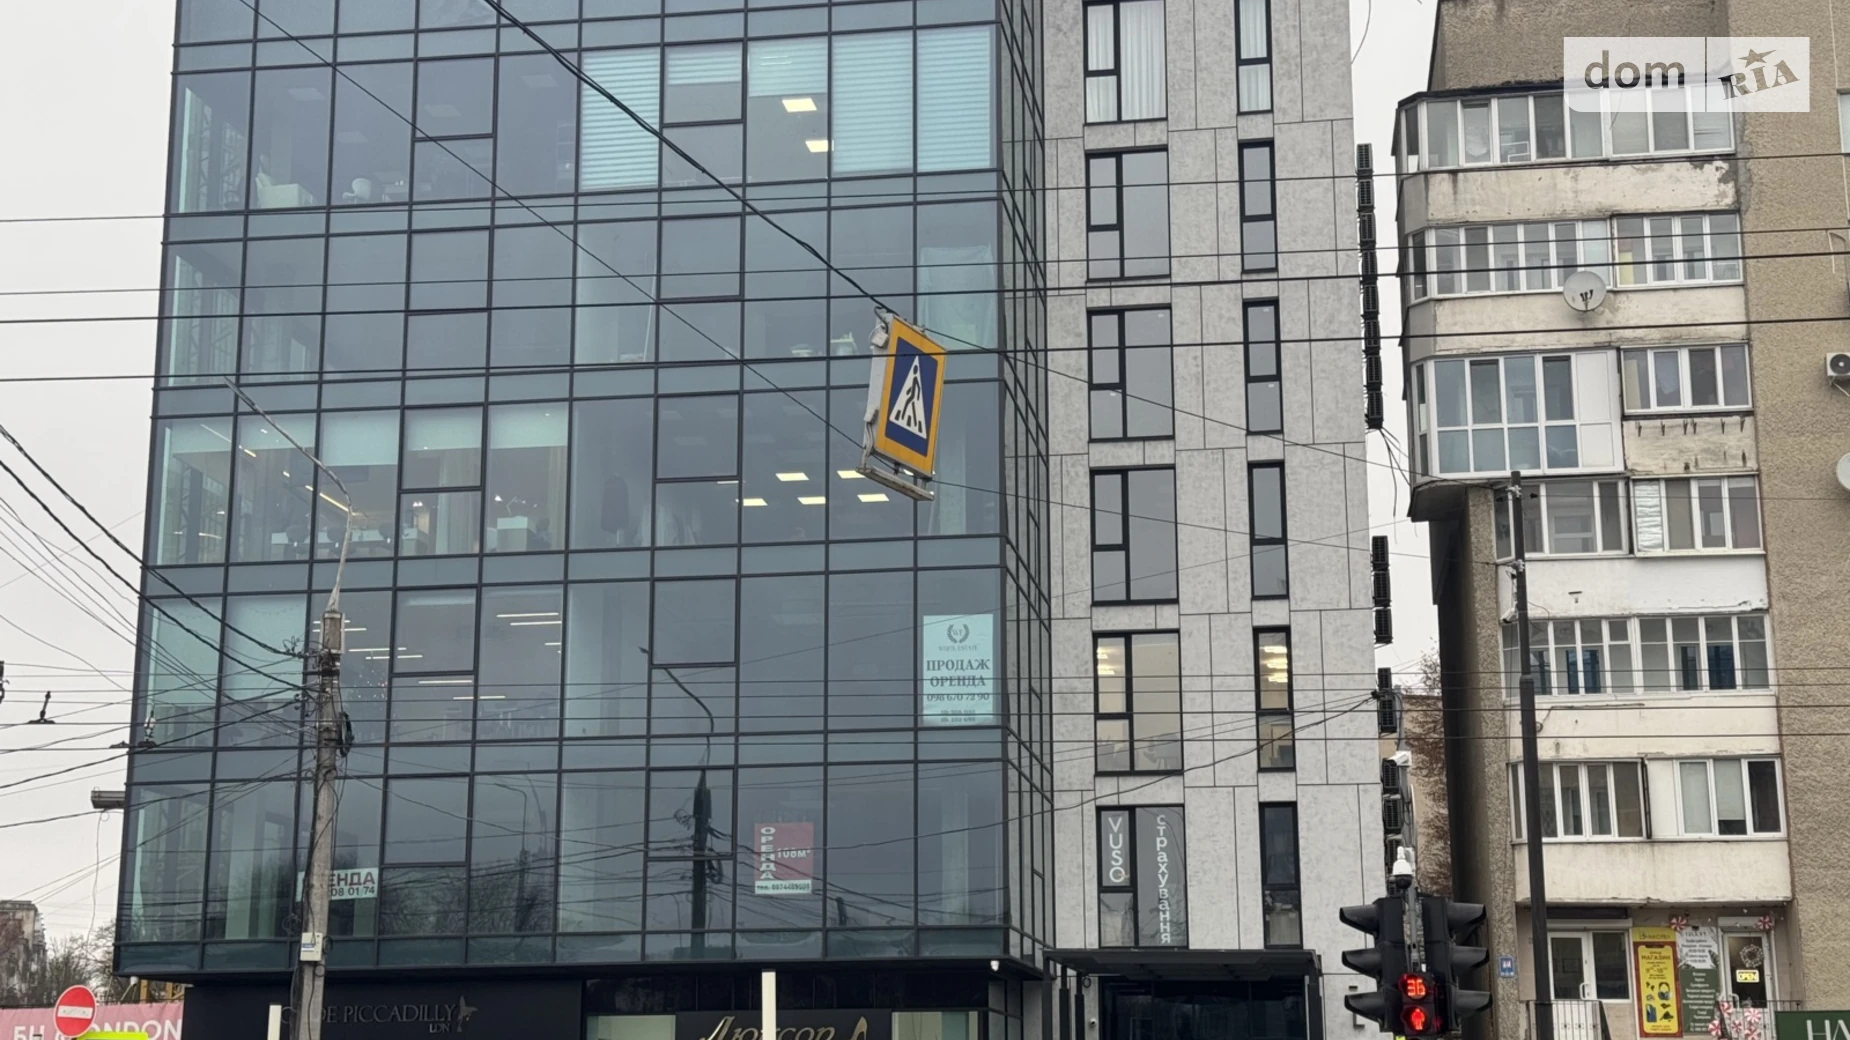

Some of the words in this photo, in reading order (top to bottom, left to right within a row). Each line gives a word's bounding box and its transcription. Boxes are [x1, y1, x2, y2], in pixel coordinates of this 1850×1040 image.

[926, 659, 990, 671] ПРОДАЖ
[930, 675, 986, 688] ОРЕНДА
[926, 693, 945, 701] 098
[946, 693, 963, 701] 670
[977, 692, 990, 701] 90
[760, 827, 776, 879] ОРЕНДА
[1108, 817, 1126, 882] VUSO
[329, 872, 375, 887] ЕНДА
[1156, 814, 1171, 943] страхування
[348, 887, 360, 896] 01
[363, 886, 375, 894] 74
[1407, 979, 1426, 996] 36
[343, 1004, 456, 1023] PICCADILLY
[699, 1016, 836, 1040] Люсор
